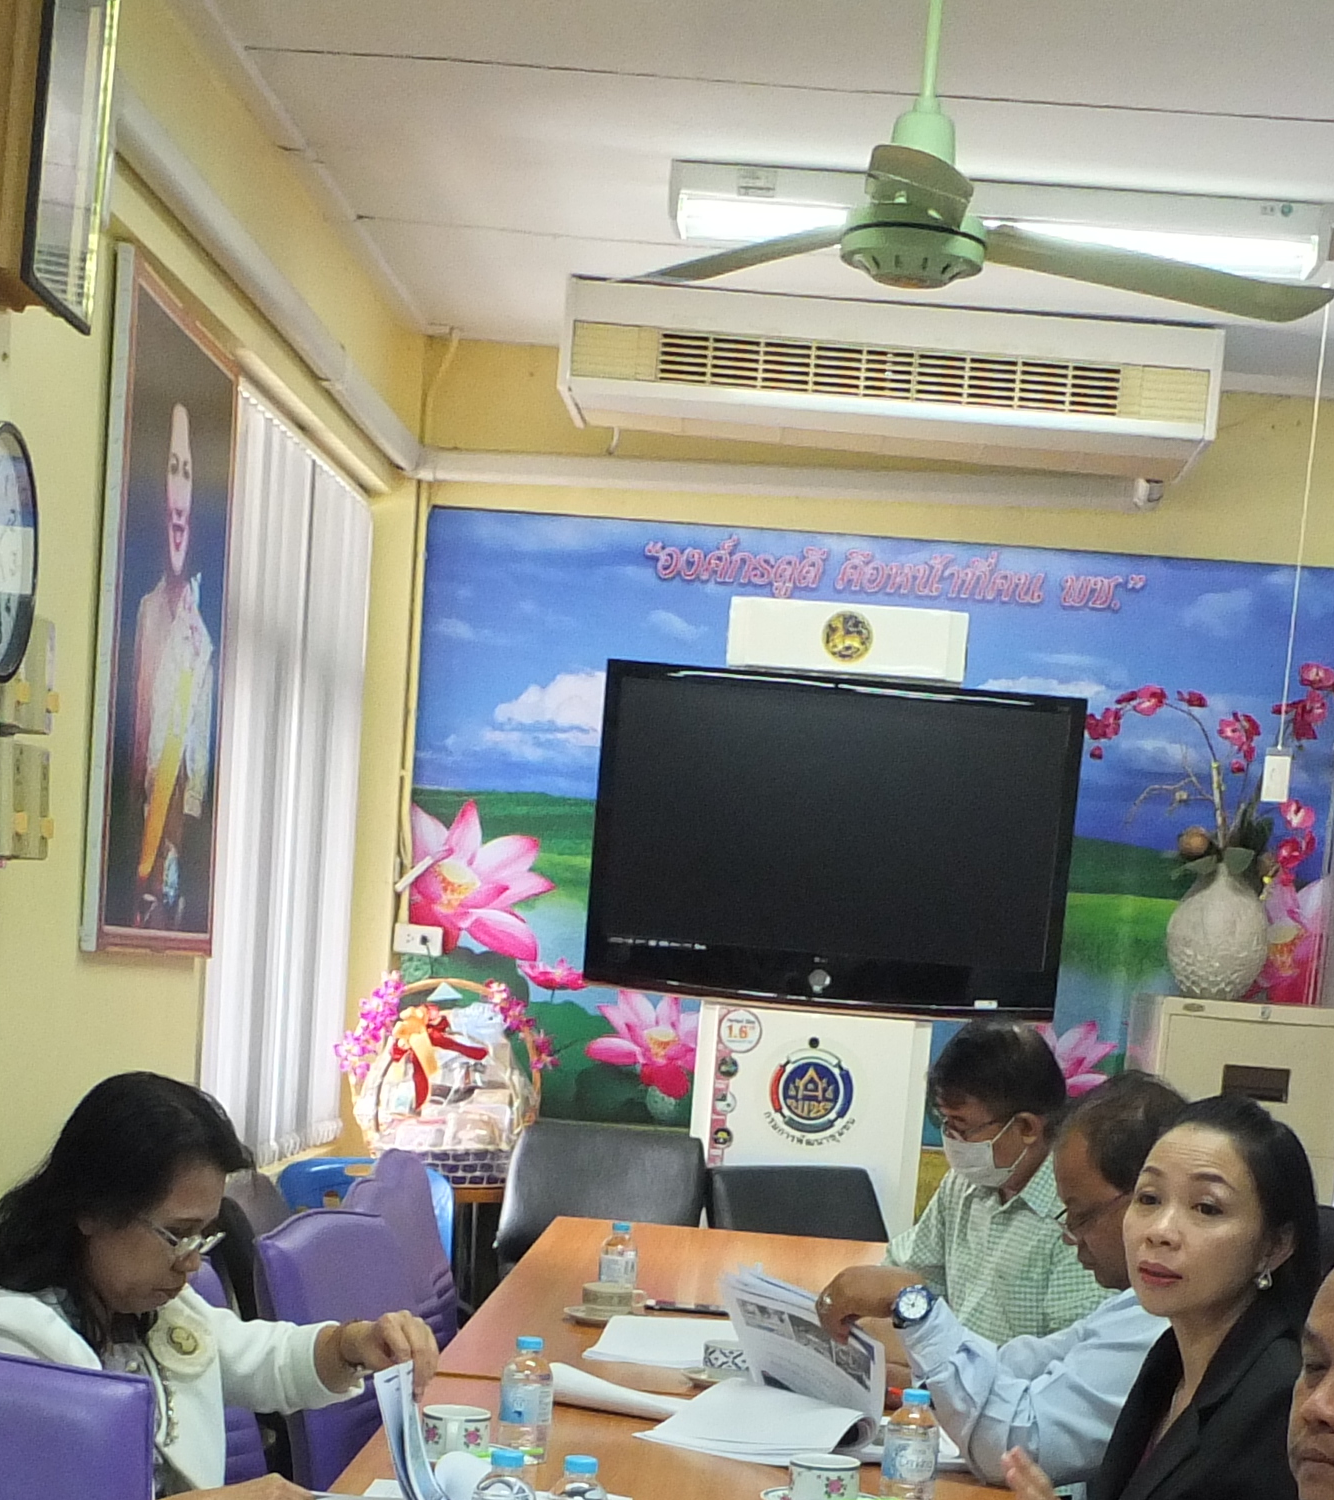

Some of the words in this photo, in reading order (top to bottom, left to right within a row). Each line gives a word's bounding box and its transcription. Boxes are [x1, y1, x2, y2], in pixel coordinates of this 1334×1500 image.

[835, 548, 1045, 606] คือหน้าที่คน
